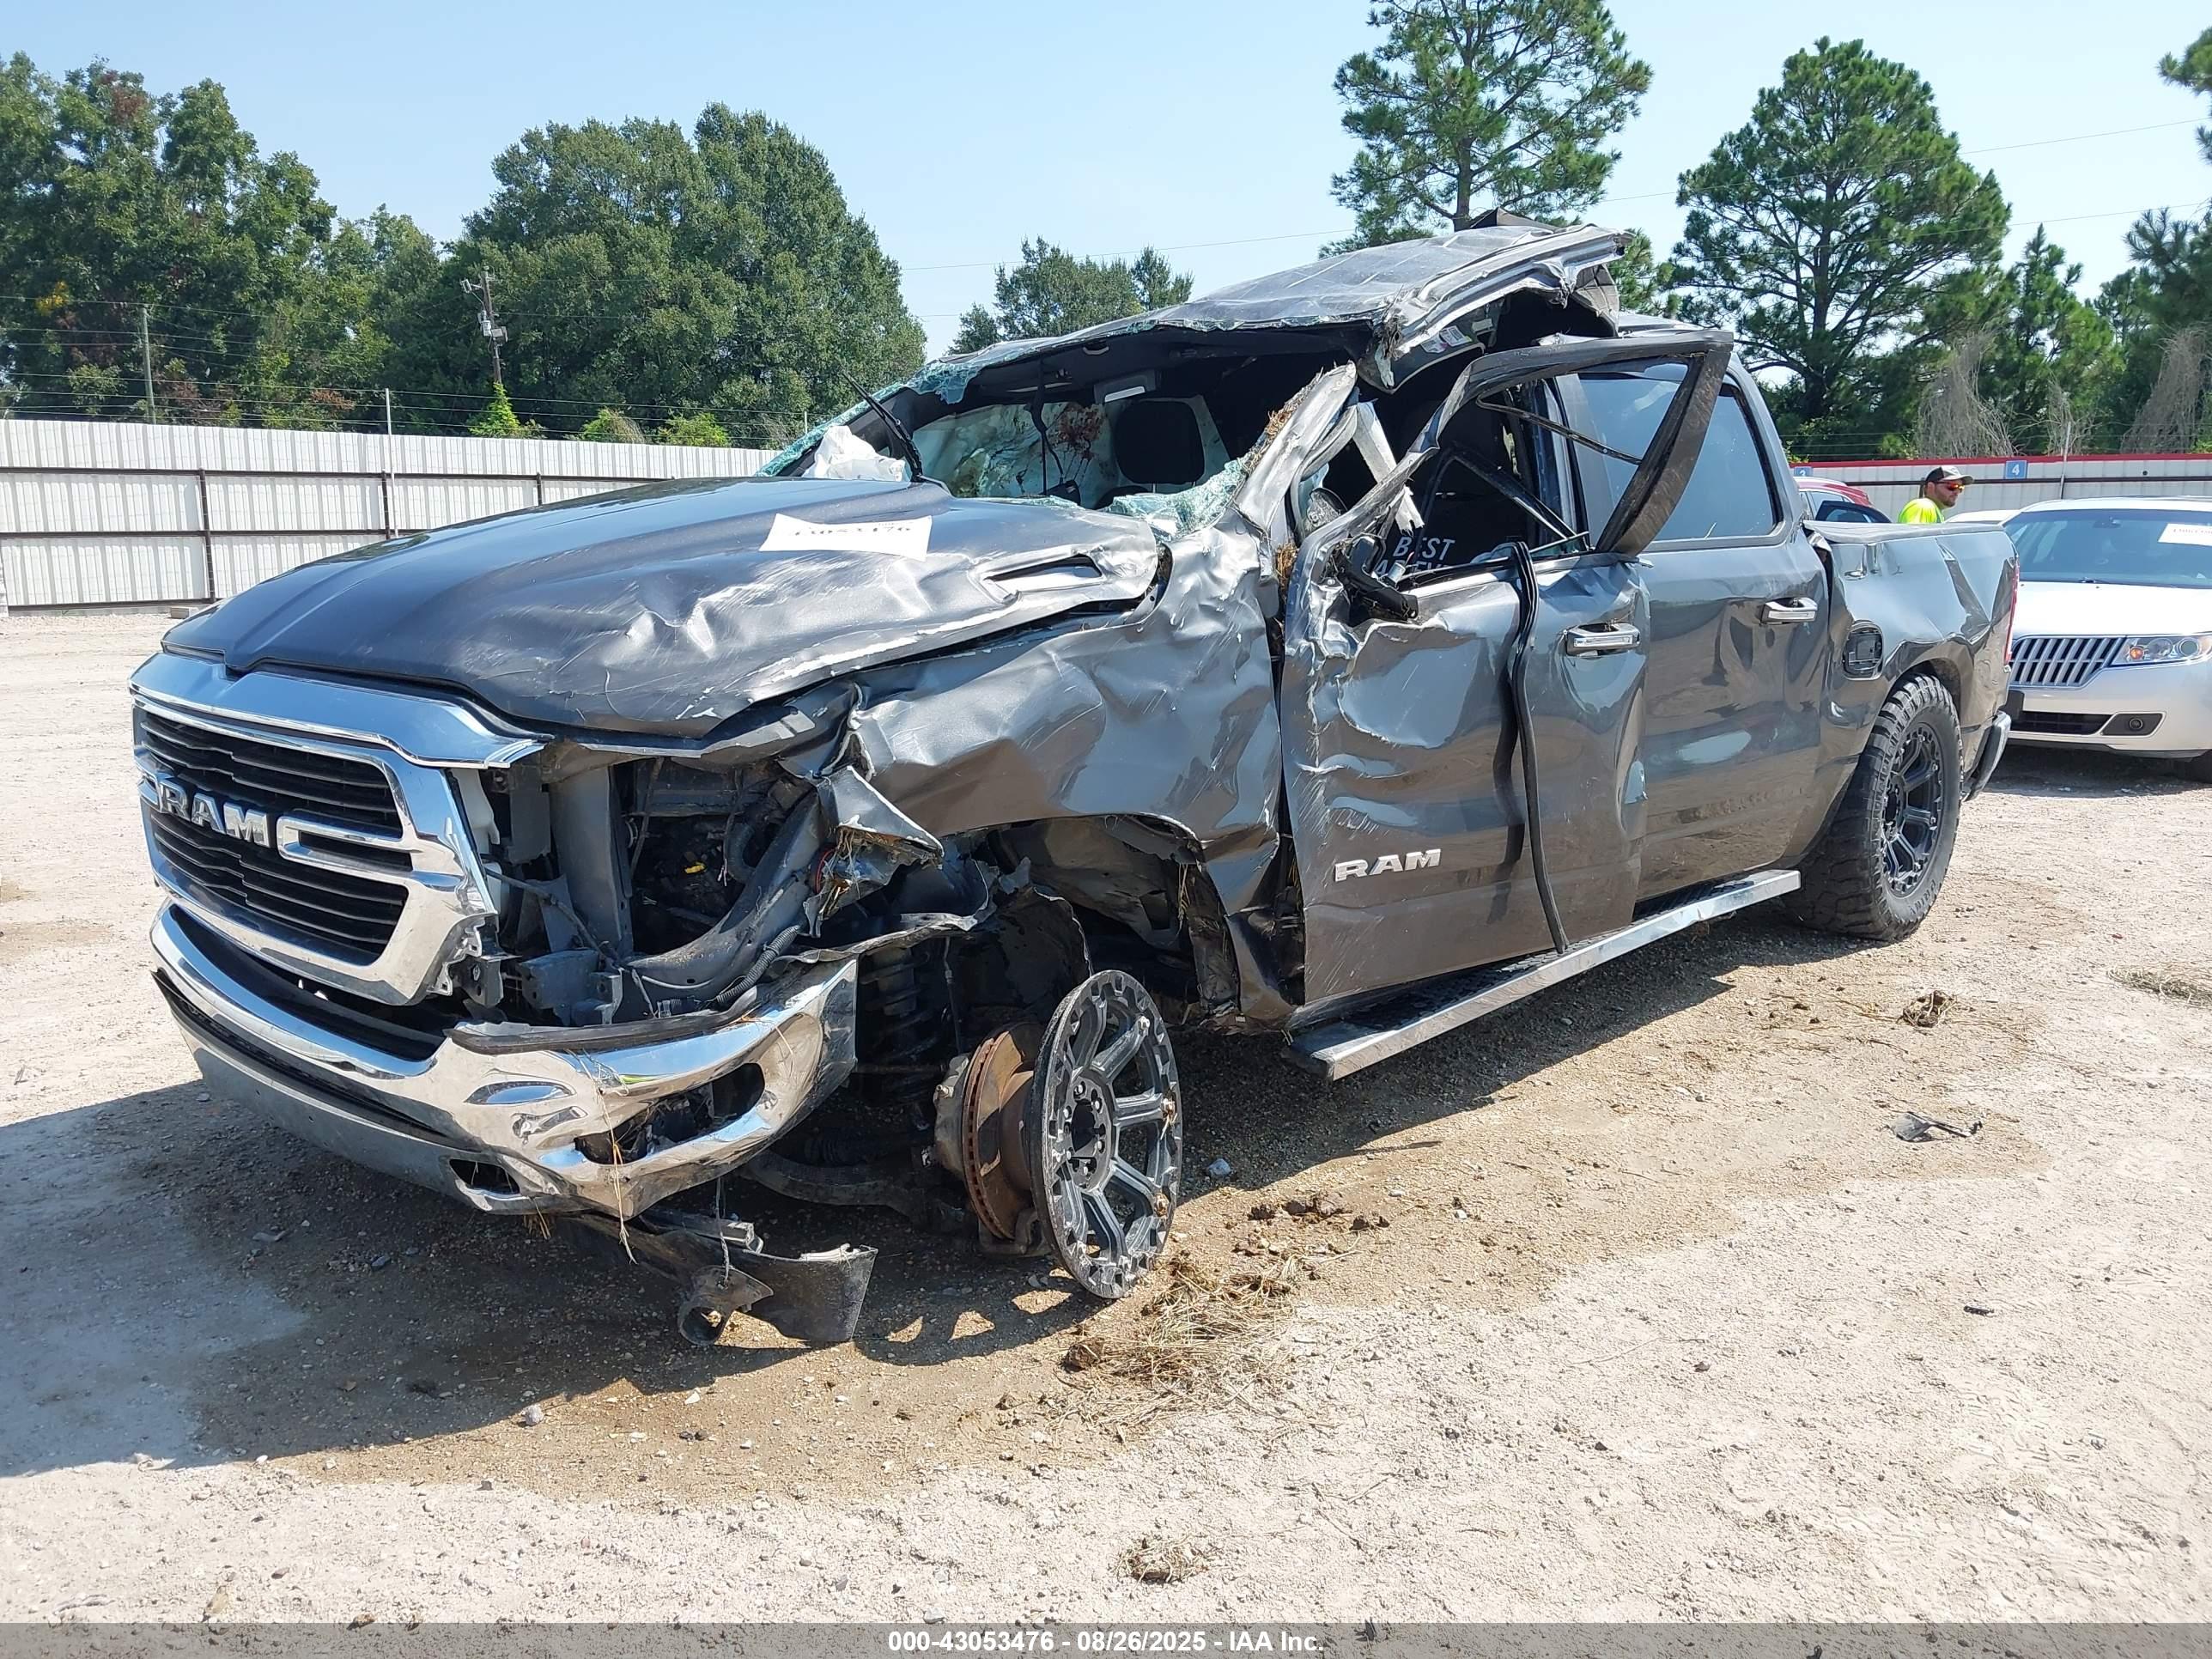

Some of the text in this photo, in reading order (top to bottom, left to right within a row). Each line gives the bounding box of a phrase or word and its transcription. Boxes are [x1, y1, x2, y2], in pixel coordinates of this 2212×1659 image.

[2011, 464, 2021, 476] 4
[1393, 536, 1456, 561] BST
[158, 776, 270, 848] RAM
[1334, 848, 1442, 883] RAM
